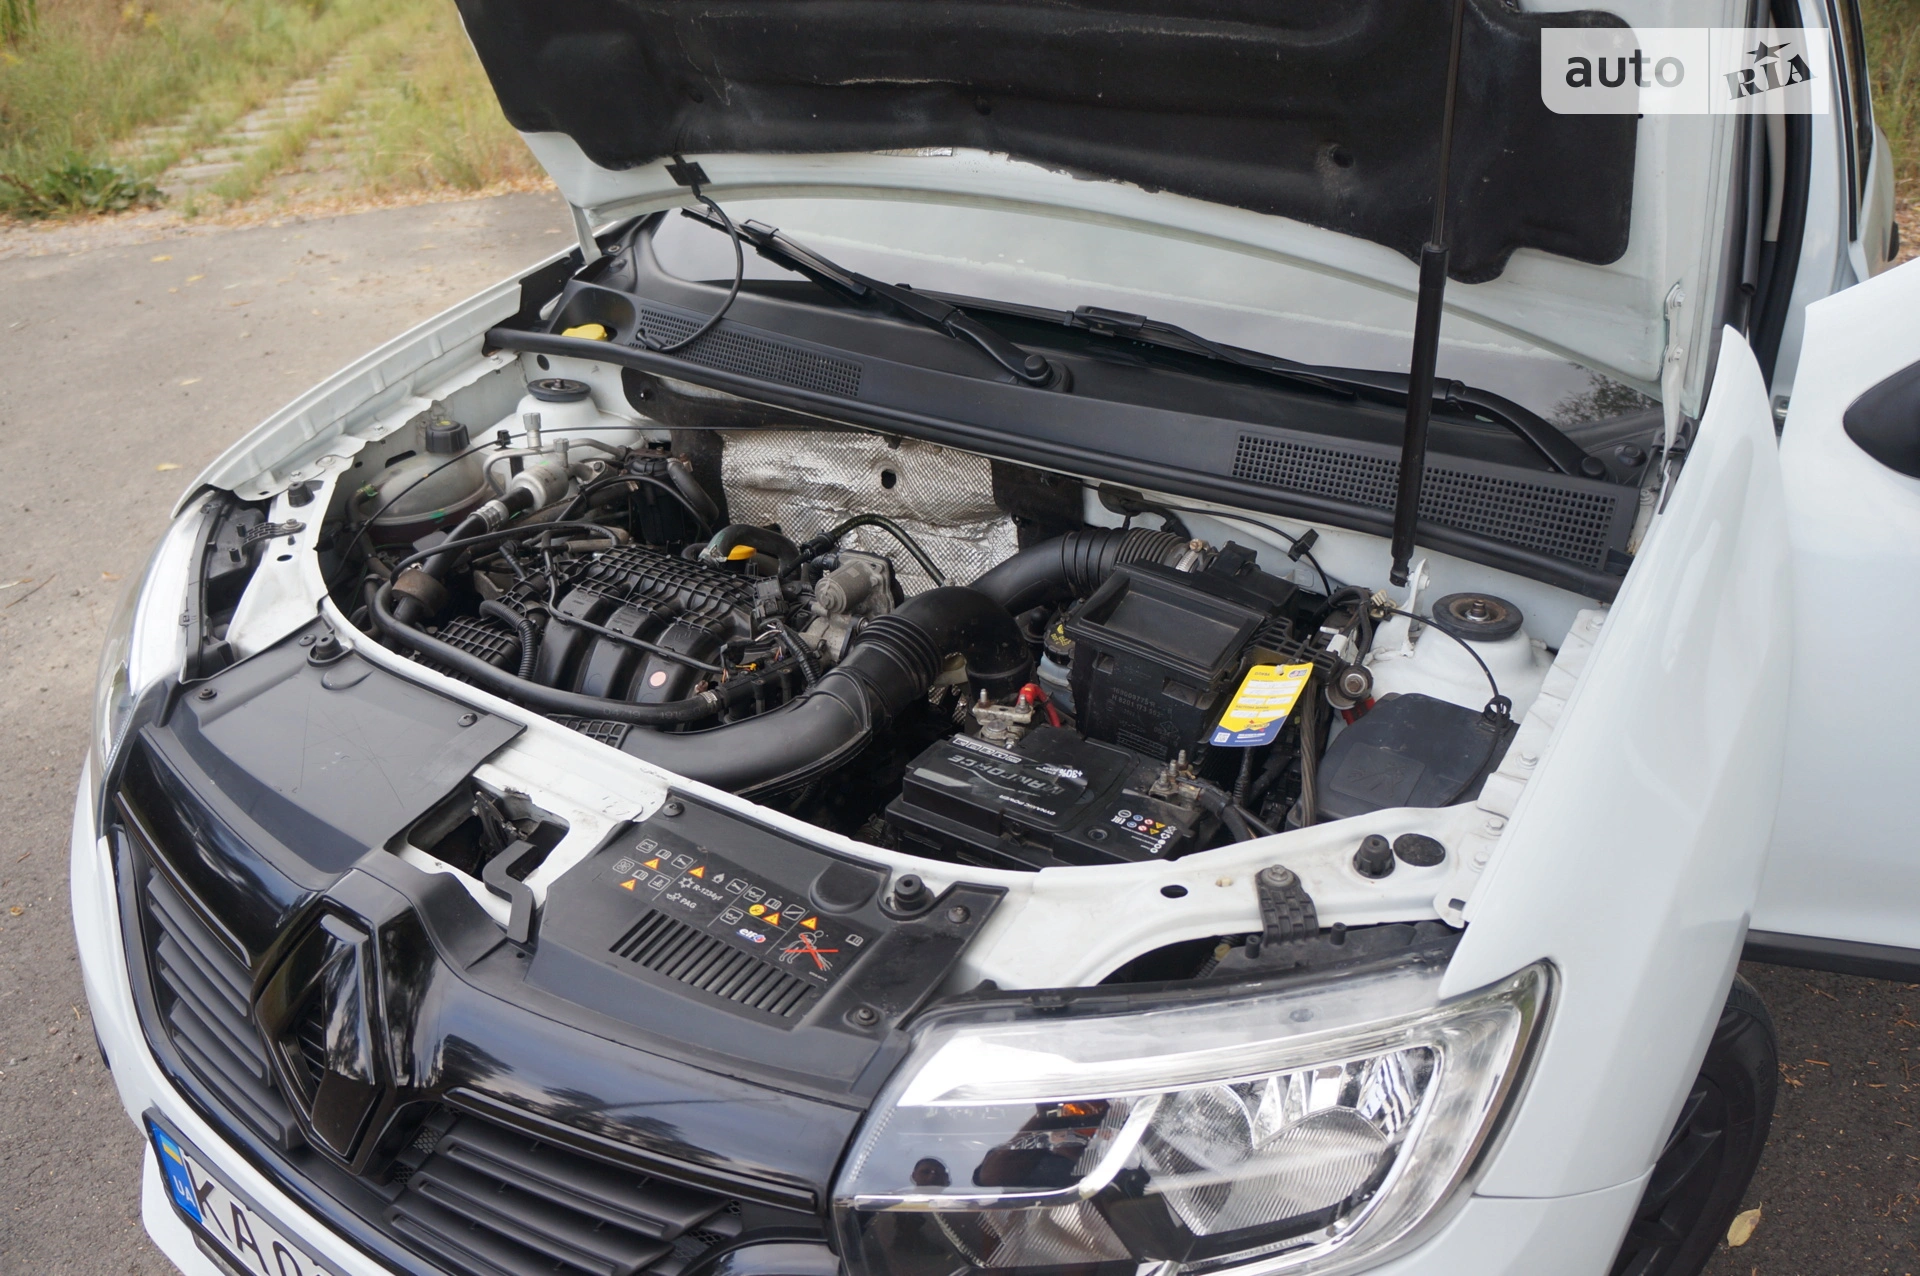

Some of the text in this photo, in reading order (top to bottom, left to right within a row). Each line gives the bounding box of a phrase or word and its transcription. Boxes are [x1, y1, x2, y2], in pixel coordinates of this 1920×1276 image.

[999, 794, 1057, 816] DYNAMIC POWER
[692, 884, 723, 901] R-1234yf
[680, 898, 698, 909] PAG
[173, 1175, 196, 1207] UA
